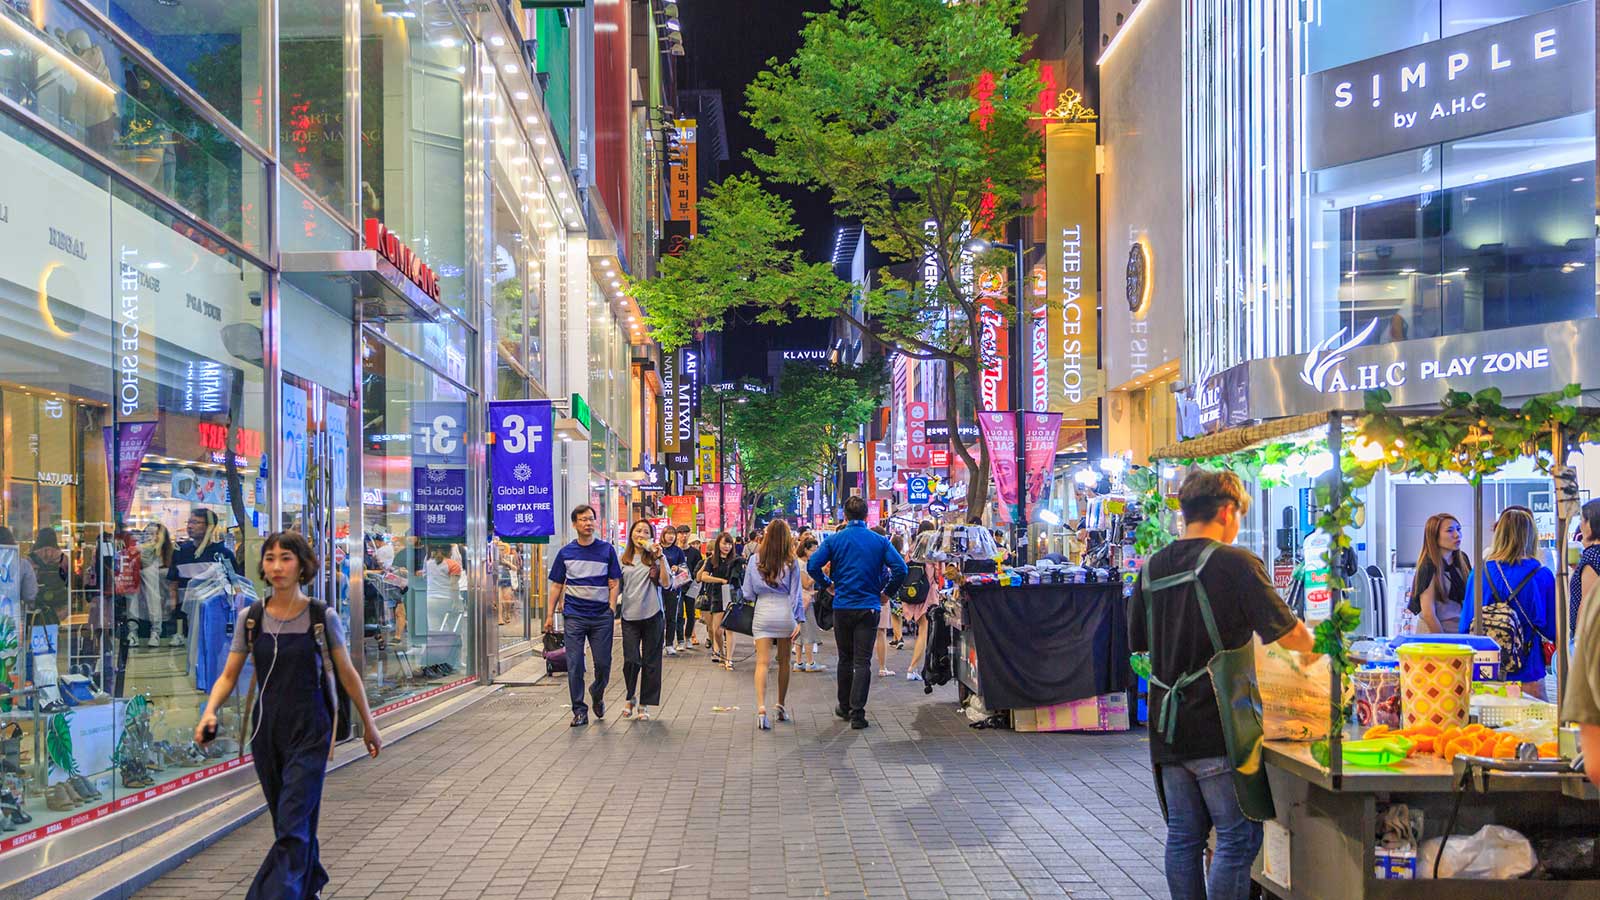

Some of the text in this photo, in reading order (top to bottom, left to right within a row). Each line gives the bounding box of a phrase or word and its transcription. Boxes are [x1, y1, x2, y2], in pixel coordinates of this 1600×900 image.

[1394, 92, 1487, 128] by A.H.C
[49, 227, 87, 261] REGAL
[120, 261, 160, 293] HITAGE
[1063, 225, 1082, 403] THE FACE SHOP
[784, 351, 826, 359] KLAVUU
[1328, 348, 1549, 393] A.H.C PLAY ZONE
[664, 355, 673, 446] NATURE REPUBLIC
[502, 414, 543, 453] 3F
[496, 502, 551, 511] SHOP TAX FREE
[498, 485, 548, 495] Global Blue
